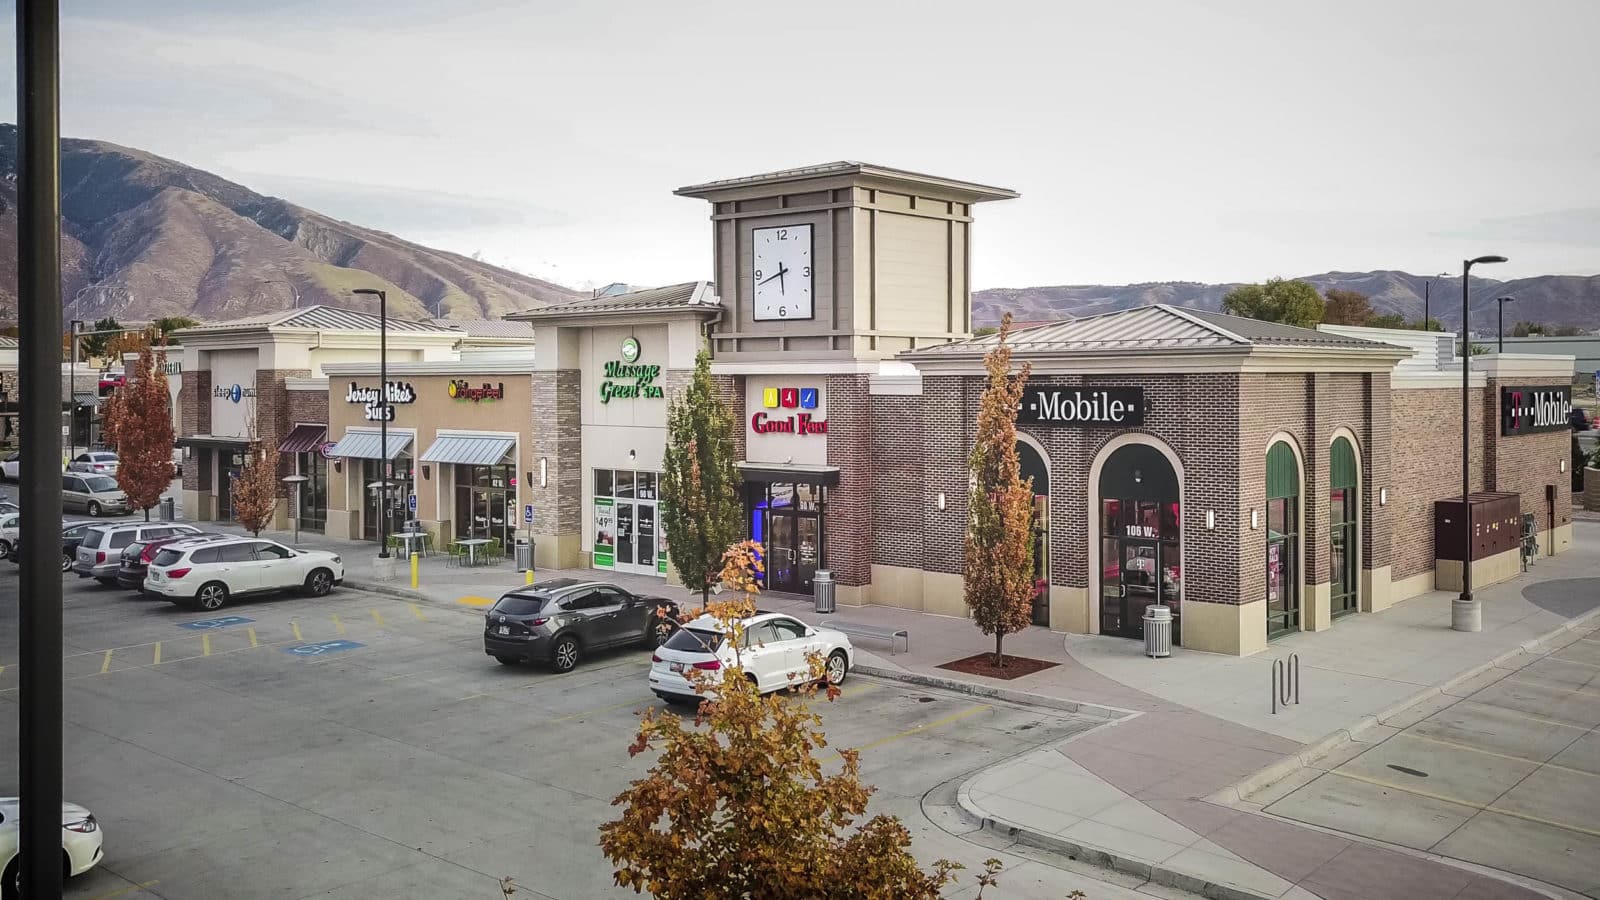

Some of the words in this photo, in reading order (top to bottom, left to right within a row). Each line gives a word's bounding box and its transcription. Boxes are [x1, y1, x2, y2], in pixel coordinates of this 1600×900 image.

[777, 230, 788, 241] 12
[755, 269, 763, 281] 9
[803, 266, 811, 278] 3
[779, 305, 787, 317] 6
[604, 360, 660, 384] Massage
[345, 383, 379, 407] Jersey
[600, 381, 641, 404] Green
[1037, 391, 1125, 421] Mobile
[752, 412, 794, 433] Good
